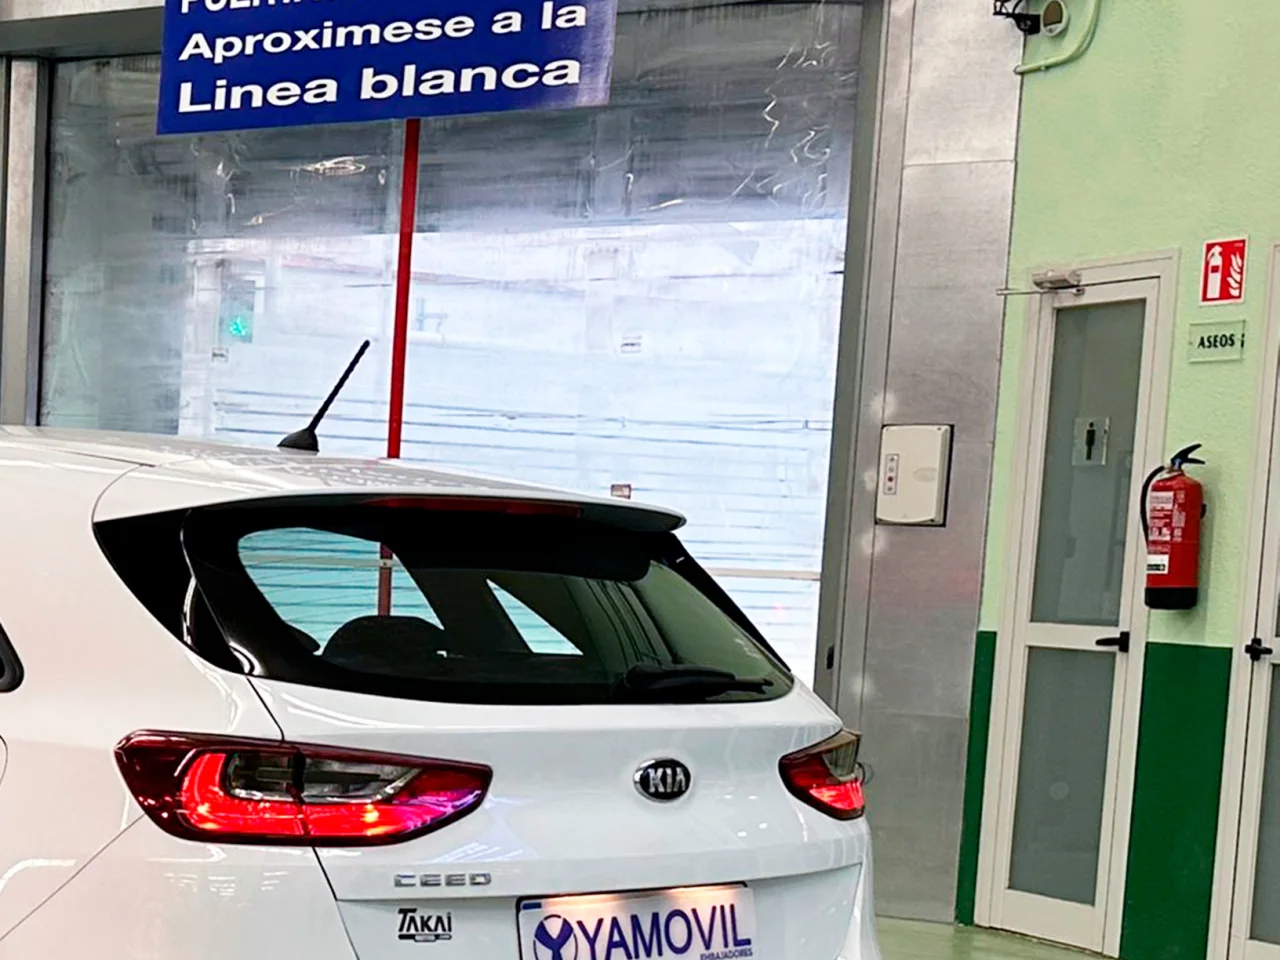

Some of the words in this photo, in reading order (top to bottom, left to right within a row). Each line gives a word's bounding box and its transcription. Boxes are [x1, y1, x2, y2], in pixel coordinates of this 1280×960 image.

[178, 14, 475, 63] Aproximese
[491, 11, 522, 33] a
[540, 1, 587, 30] la
[178, 77, 338, 113] Linea
[360, 59, 581, 100] blanca
[1198, 333, 1236, 349] ASEOS
[647, 767, 686, 793] KIA
[394, 873, 492, 888] CEED
